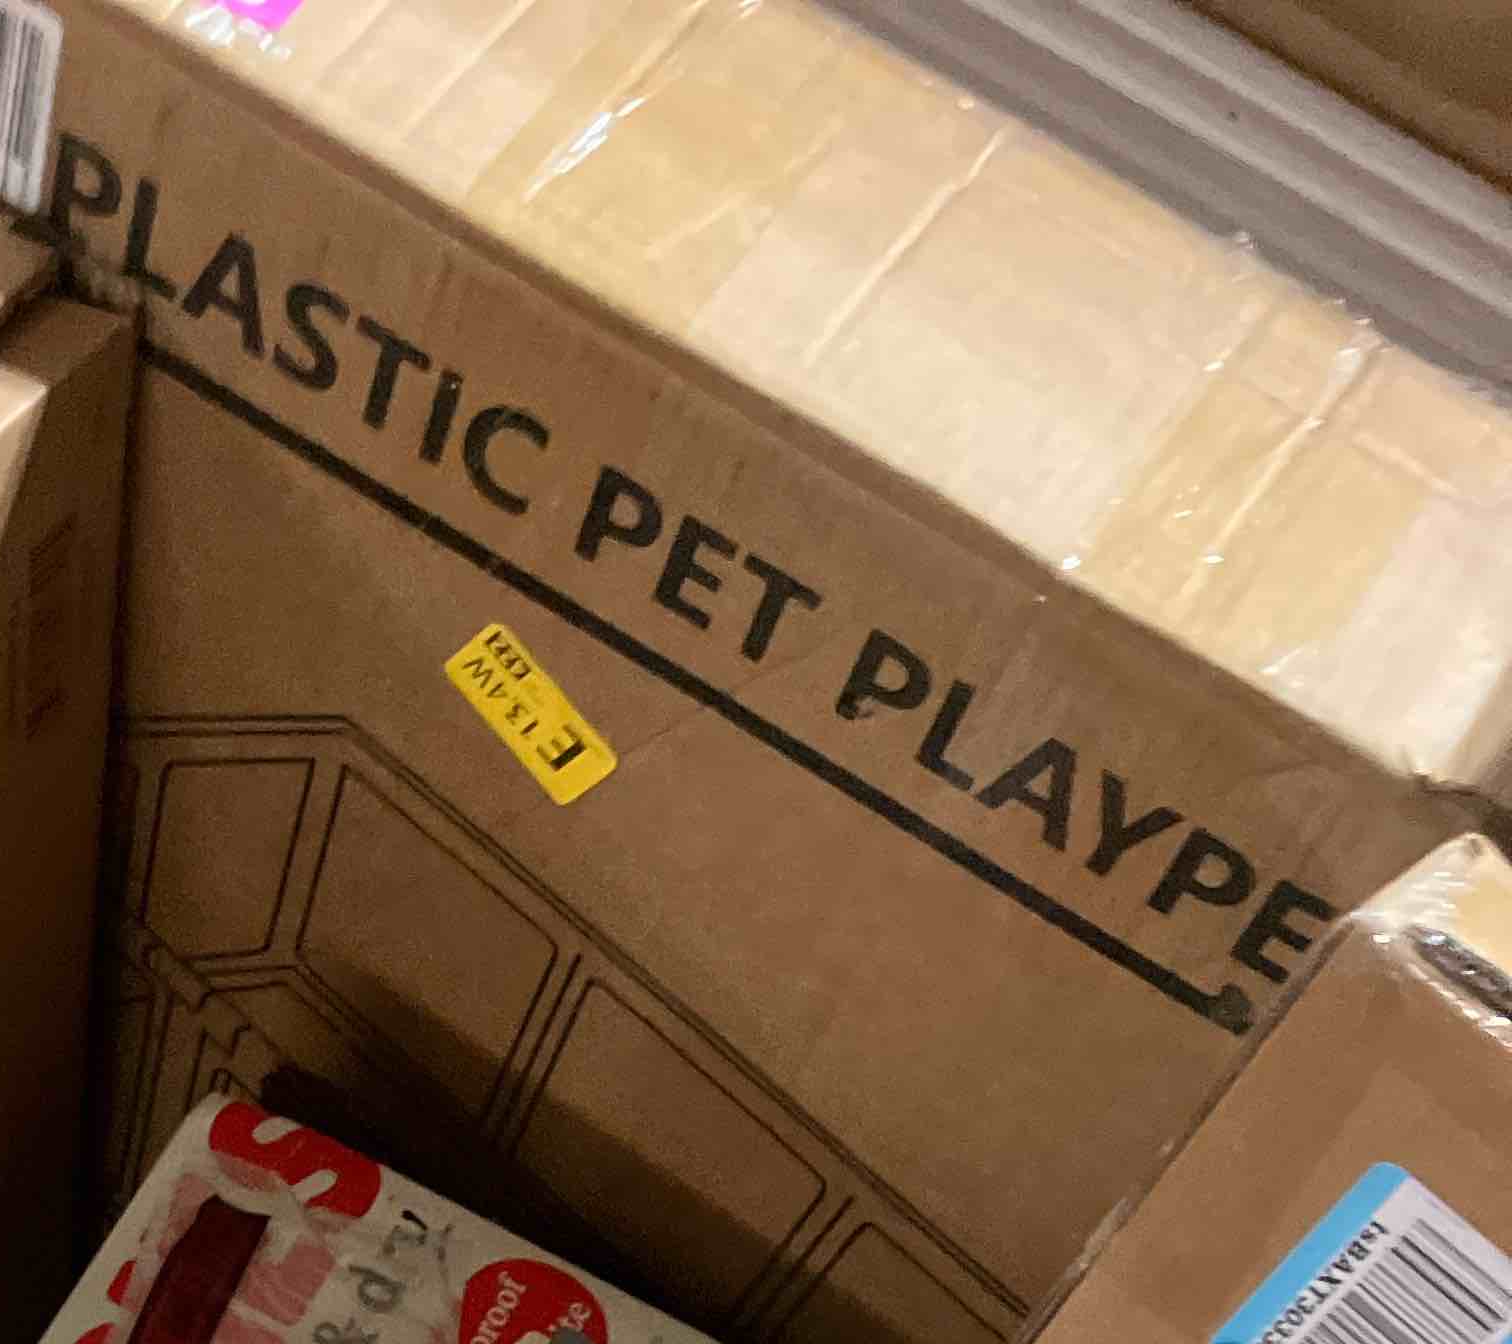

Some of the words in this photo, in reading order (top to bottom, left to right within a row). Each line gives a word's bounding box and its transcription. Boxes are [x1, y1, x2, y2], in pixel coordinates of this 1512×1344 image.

[49, 132, 549, 515] PLASTIC
[574, 464, 821, 662] PET
[835, 628, 1340, 984] PLAYPE
